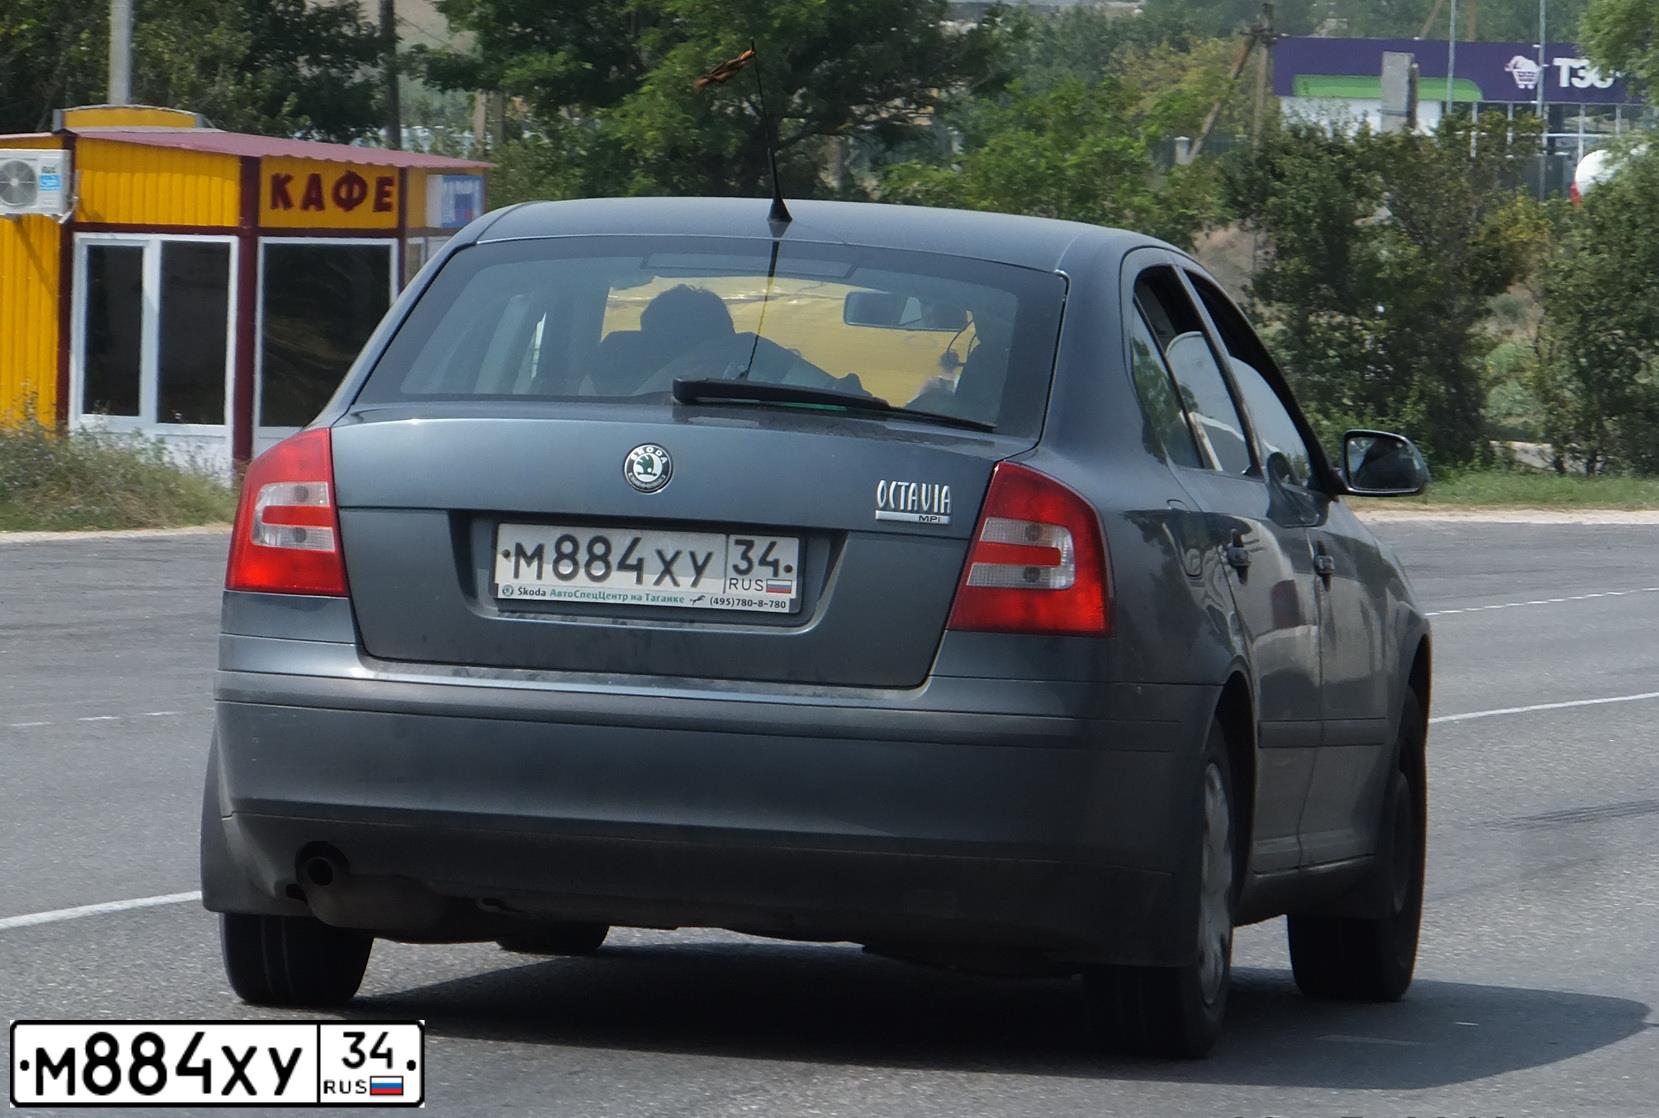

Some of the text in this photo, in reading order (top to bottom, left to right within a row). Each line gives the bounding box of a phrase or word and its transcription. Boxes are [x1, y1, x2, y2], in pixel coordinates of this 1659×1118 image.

[270, 171, 395, 212] КАФЕ
[877, 480, 951, 514] OCTAVIA
[732, 538, 780, 577] 34
[728, 577, 764, 592] RUS
